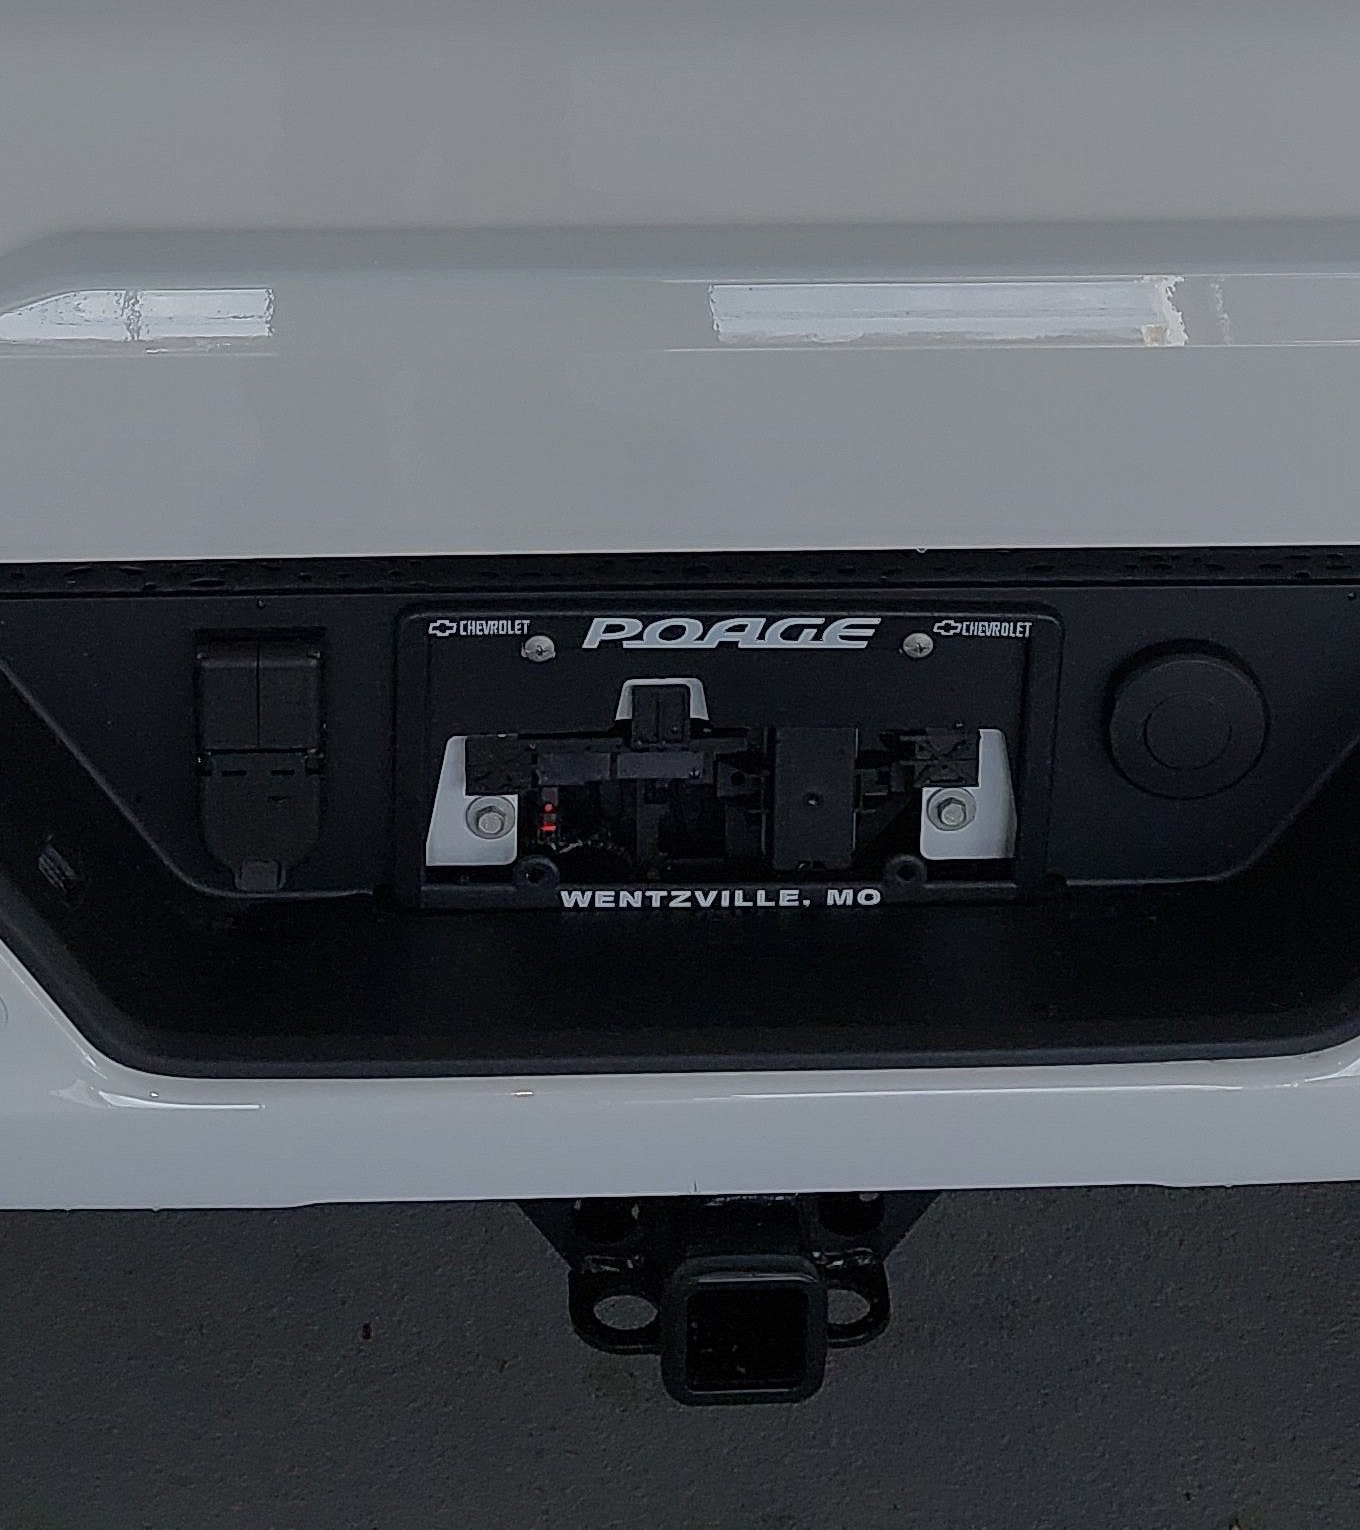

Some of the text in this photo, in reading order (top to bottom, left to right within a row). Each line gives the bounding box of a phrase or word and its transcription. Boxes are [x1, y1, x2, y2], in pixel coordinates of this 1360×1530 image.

[459, 619, 531, 637] CHEVROLET
[581, 617, 882, 649] POAGE
[960, 620, 1033, 638] CHEVROLET
[560, 888, 882, 908] WENTZVILLE, MO
